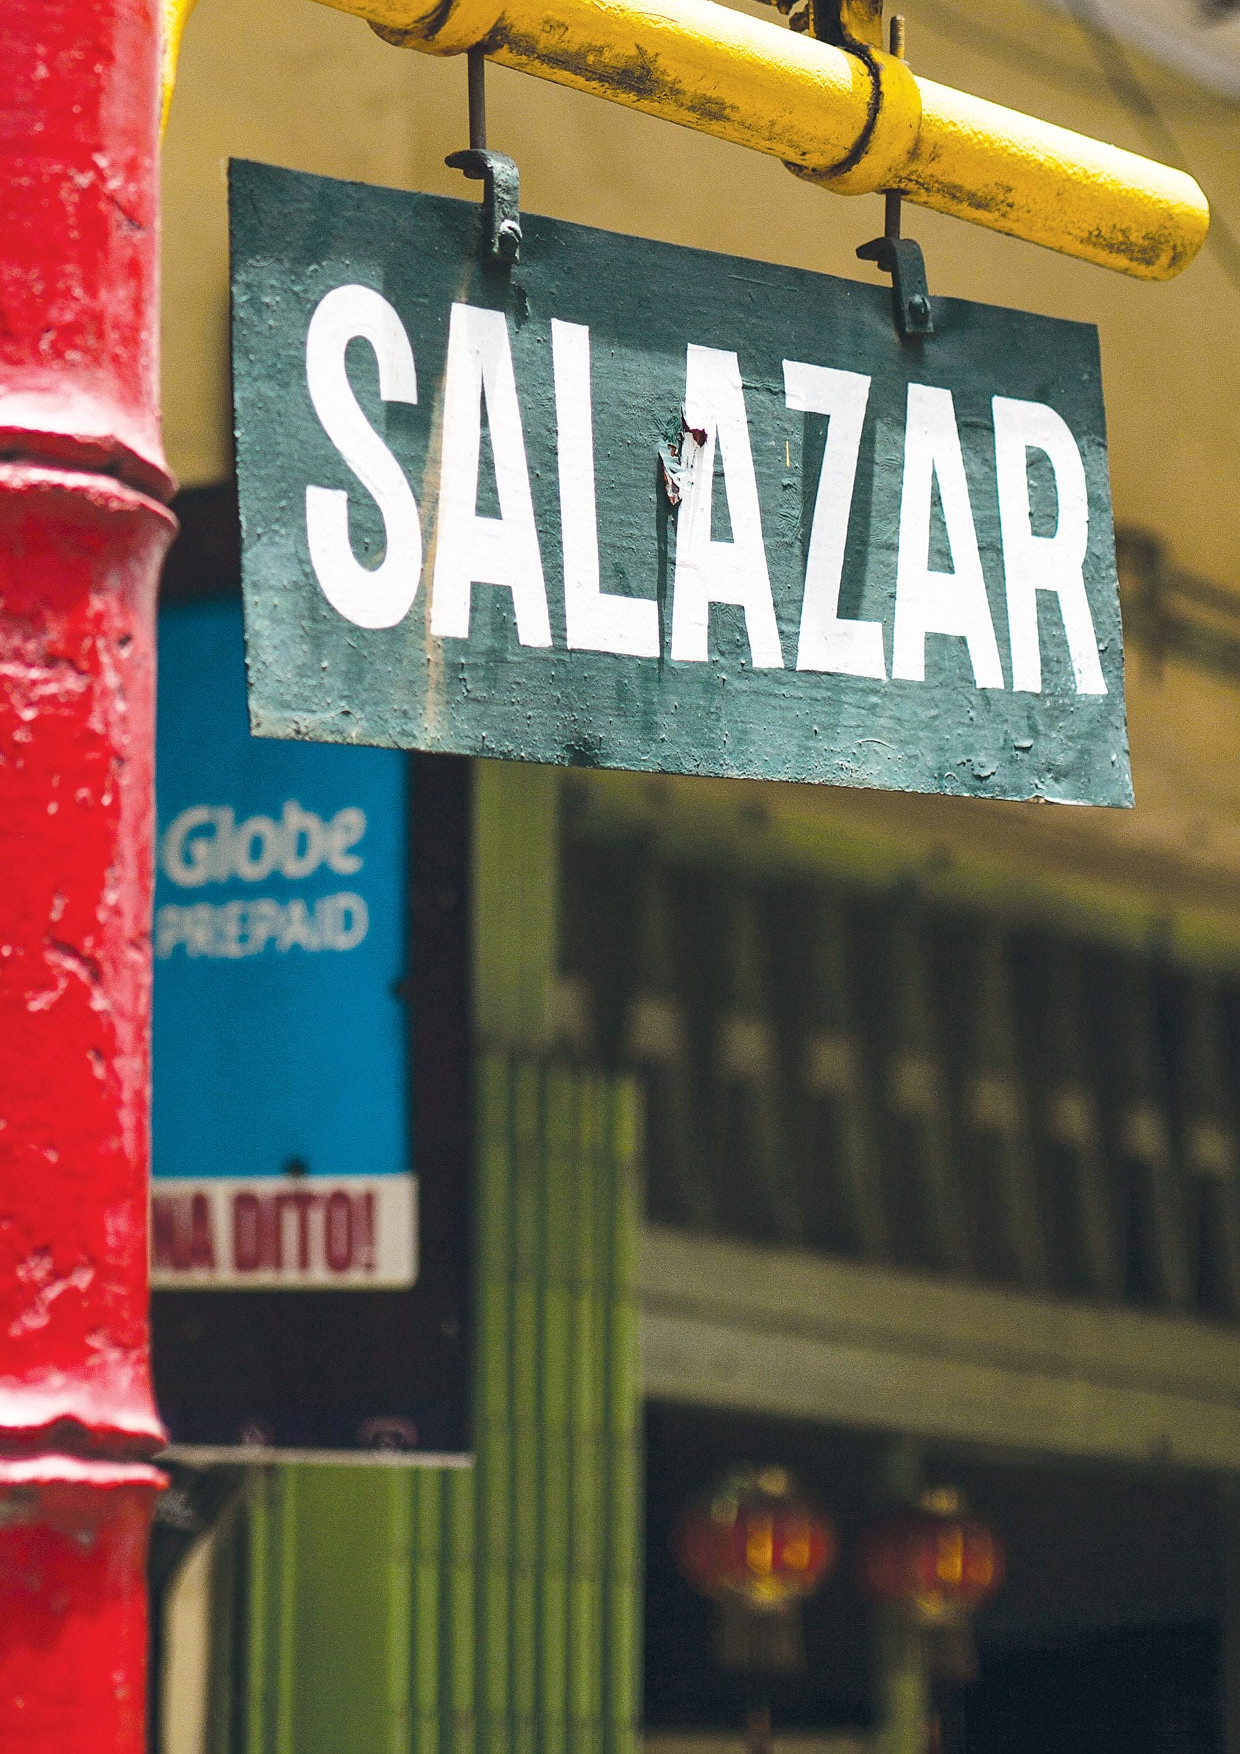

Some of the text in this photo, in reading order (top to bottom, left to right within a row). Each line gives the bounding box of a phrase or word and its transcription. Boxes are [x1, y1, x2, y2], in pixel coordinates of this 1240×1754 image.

[305, 283, 1109, 696] SALAZAR
[162, 798, 368, 888] Globe
[155, 891, 370, 960] PREPAID
